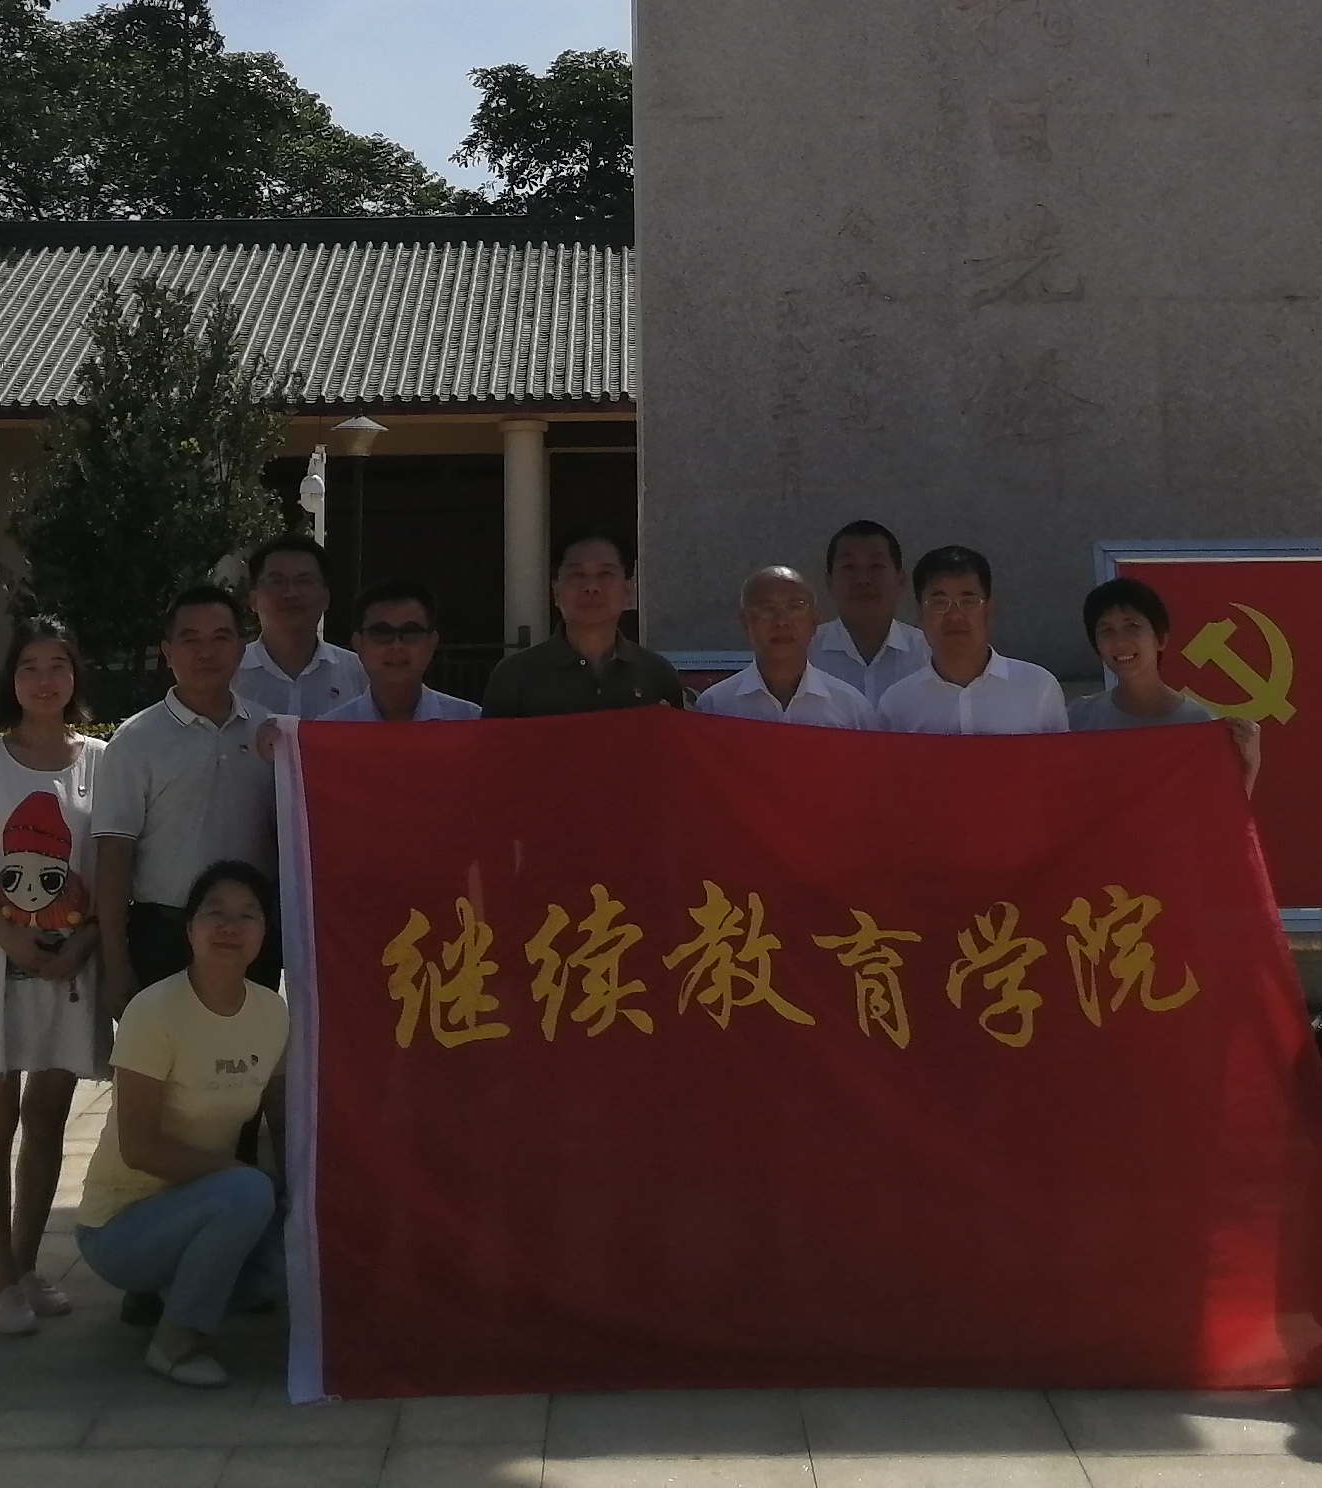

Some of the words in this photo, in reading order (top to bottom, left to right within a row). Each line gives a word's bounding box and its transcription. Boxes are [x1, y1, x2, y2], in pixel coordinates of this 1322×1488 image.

[382, 881, 1200, 1049] 继续教育学院
[215, 1059, 249, 1075] FILA
